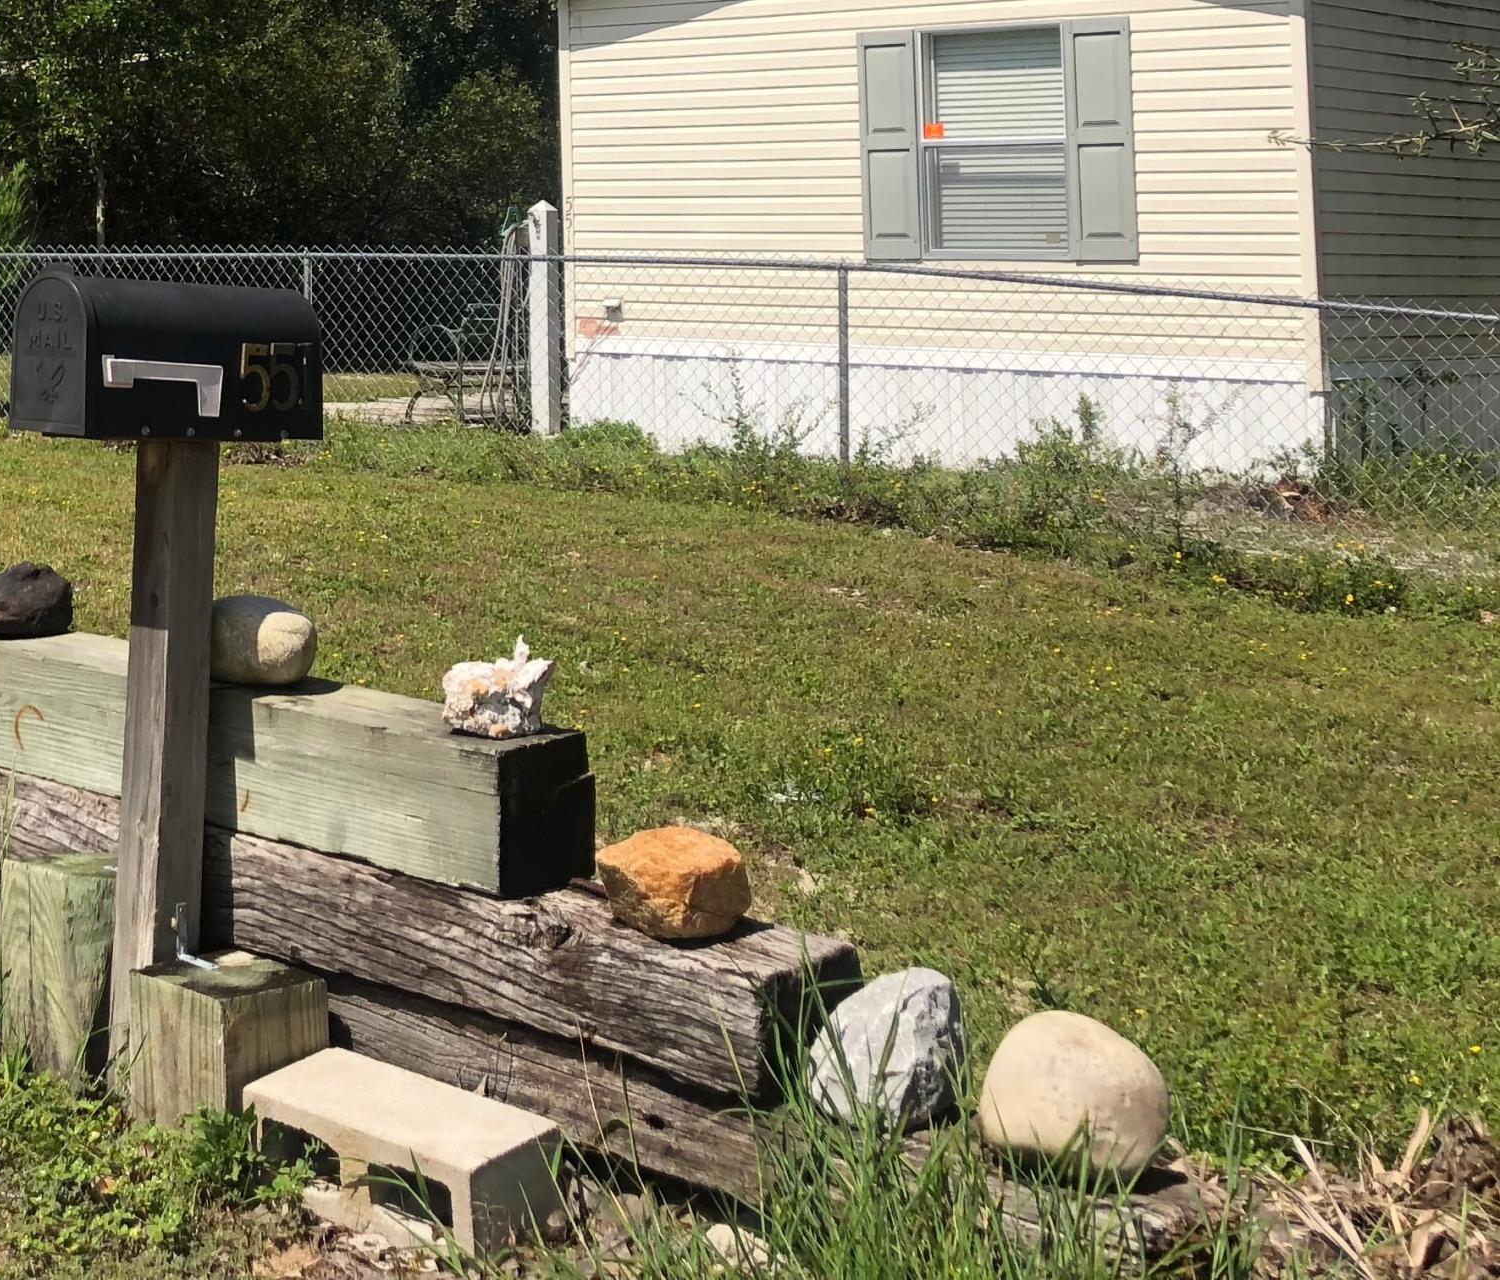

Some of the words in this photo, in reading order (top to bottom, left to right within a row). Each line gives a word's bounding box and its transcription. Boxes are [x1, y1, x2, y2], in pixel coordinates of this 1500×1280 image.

[565, 195, 573, 246] 551
[28, 328, 73, 351] MAIL
[239, 341, 314, 413] 551
